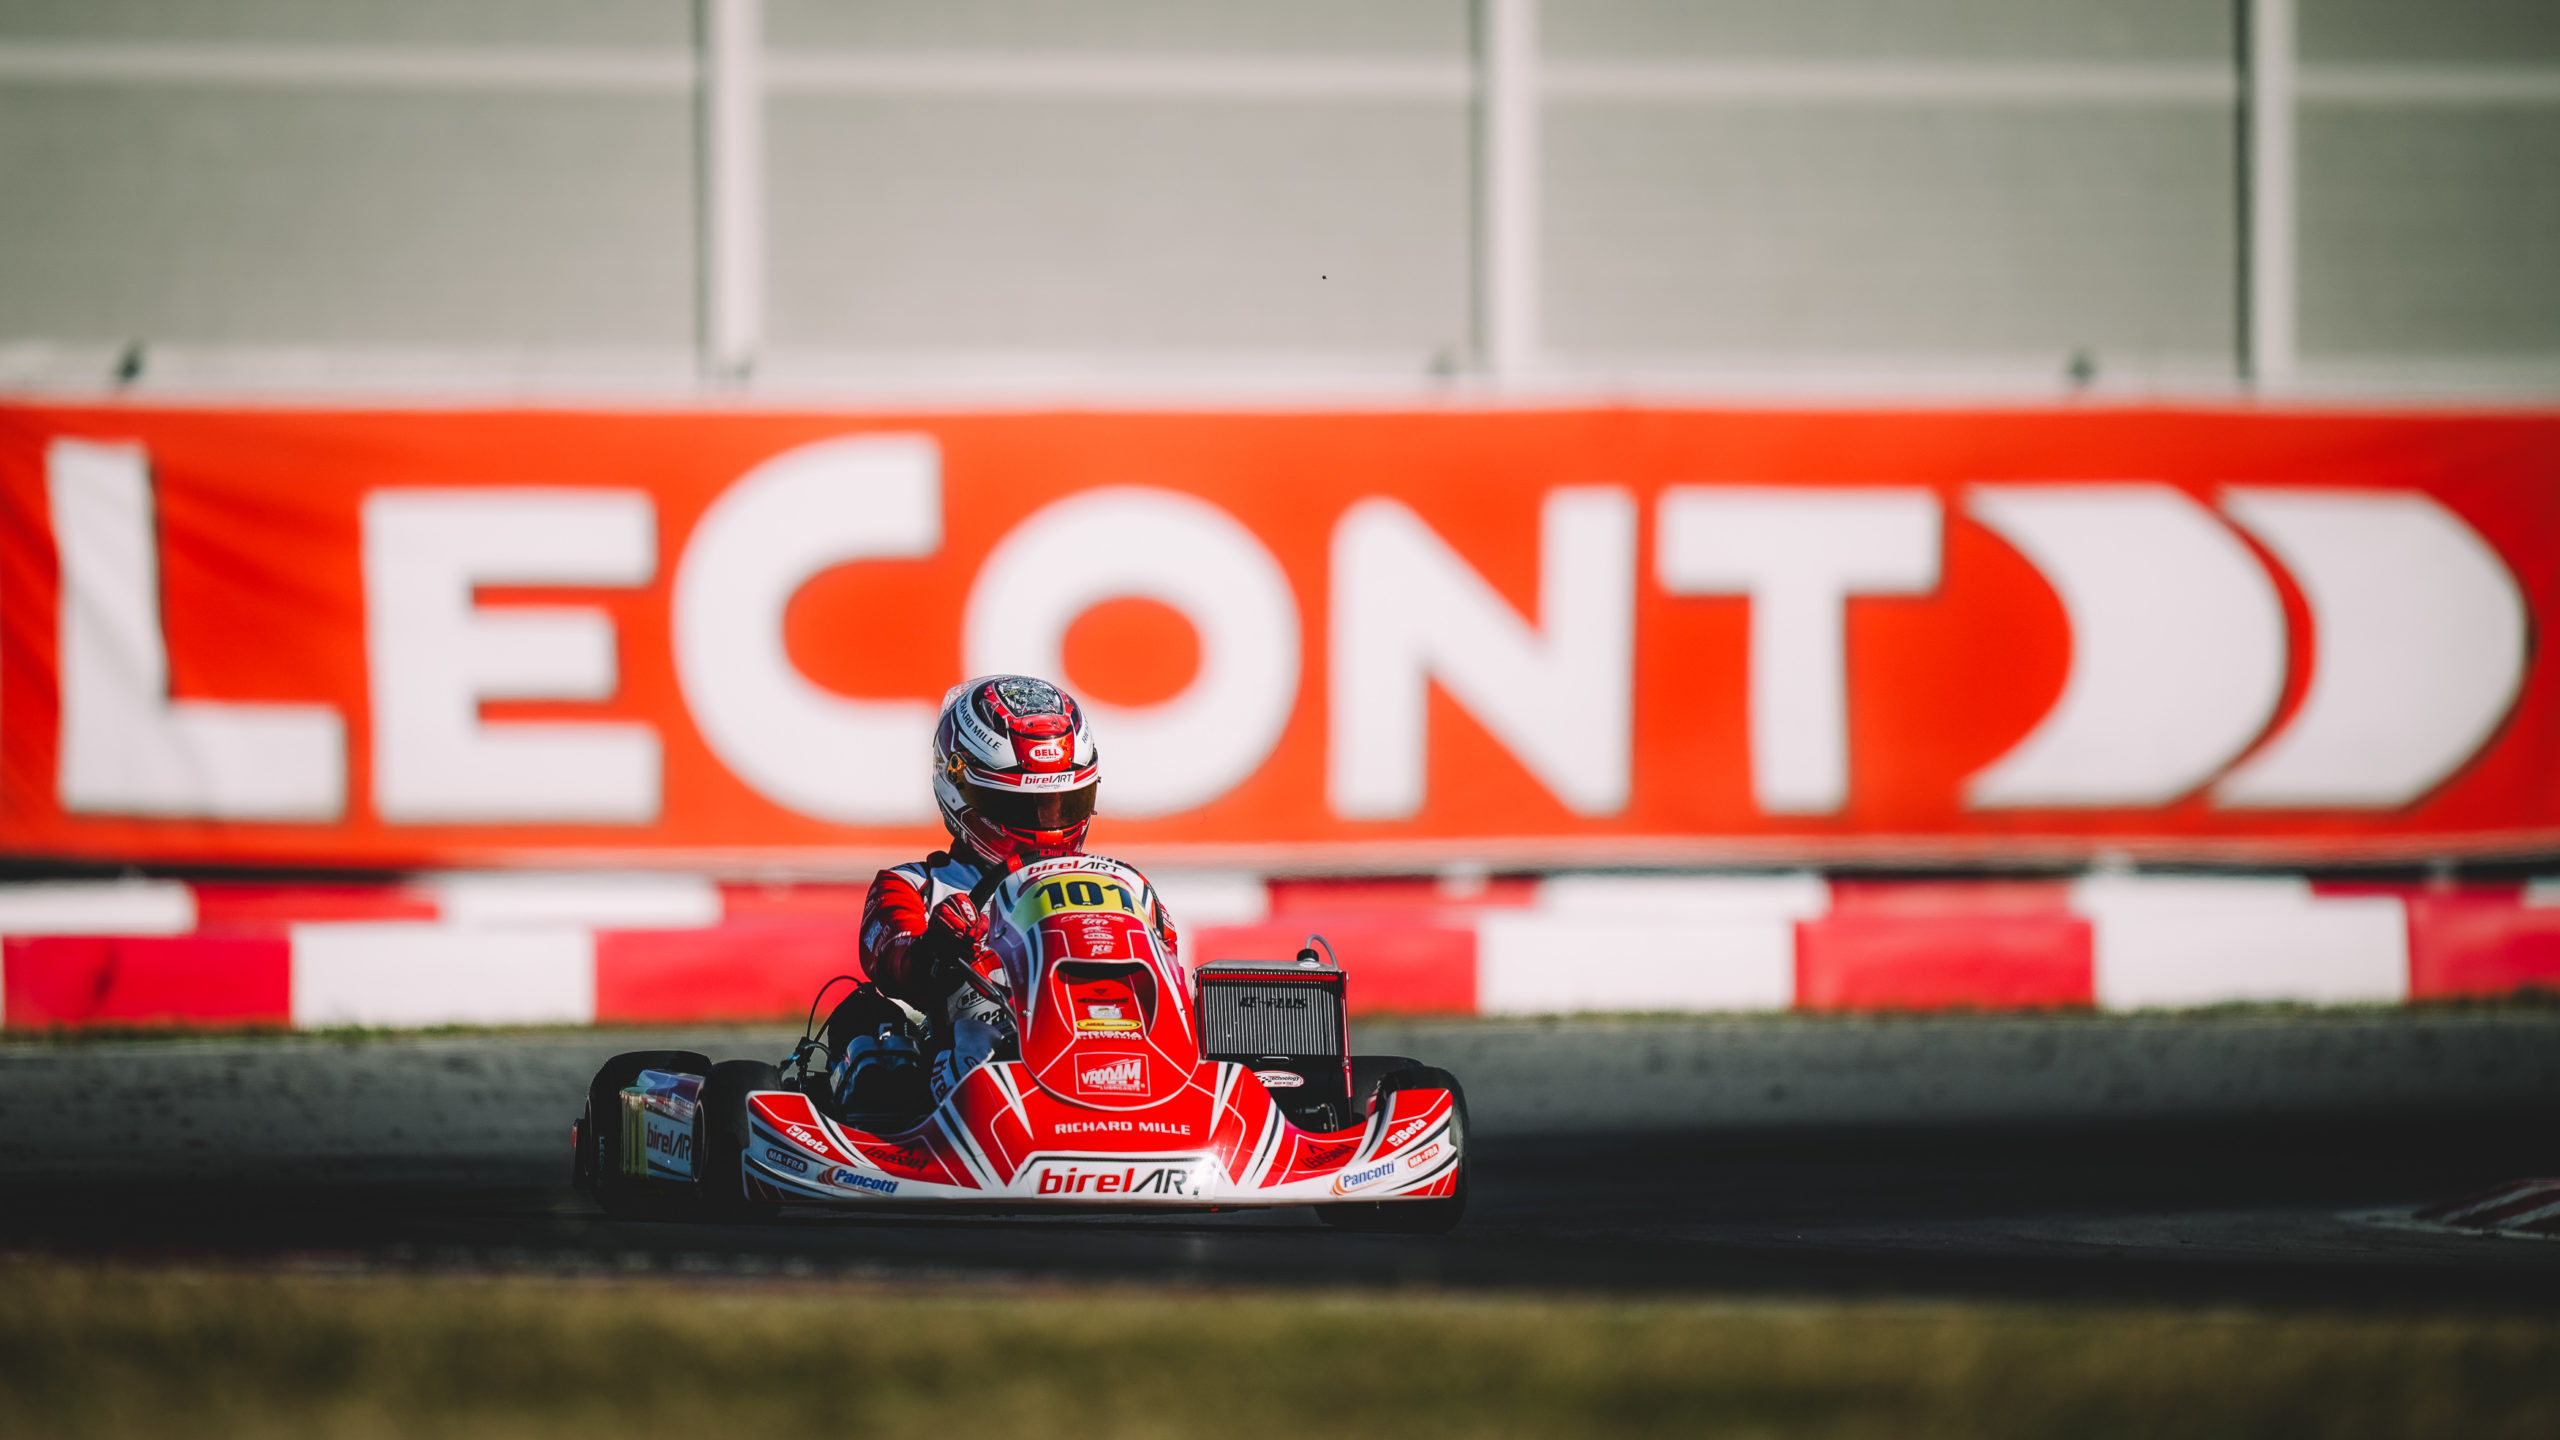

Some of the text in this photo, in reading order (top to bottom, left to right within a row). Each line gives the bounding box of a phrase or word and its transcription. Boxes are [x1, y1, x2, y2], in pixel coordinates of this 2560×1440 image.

[971, 724, 1002, 751] MILLE
[1034, 748, 1060, 757] BELL
[1032, 880, 1135, 915] 101
[646, 1121, 692, 1161] birelAR
[1055, 1121, 1191, 1136] RICHARD MILLE
[796, 1130, 829, 1154] Beta
[834, 1168, 899, 1194] Pancotti
[1343, 1160, 1394, 1188] Pancotti
